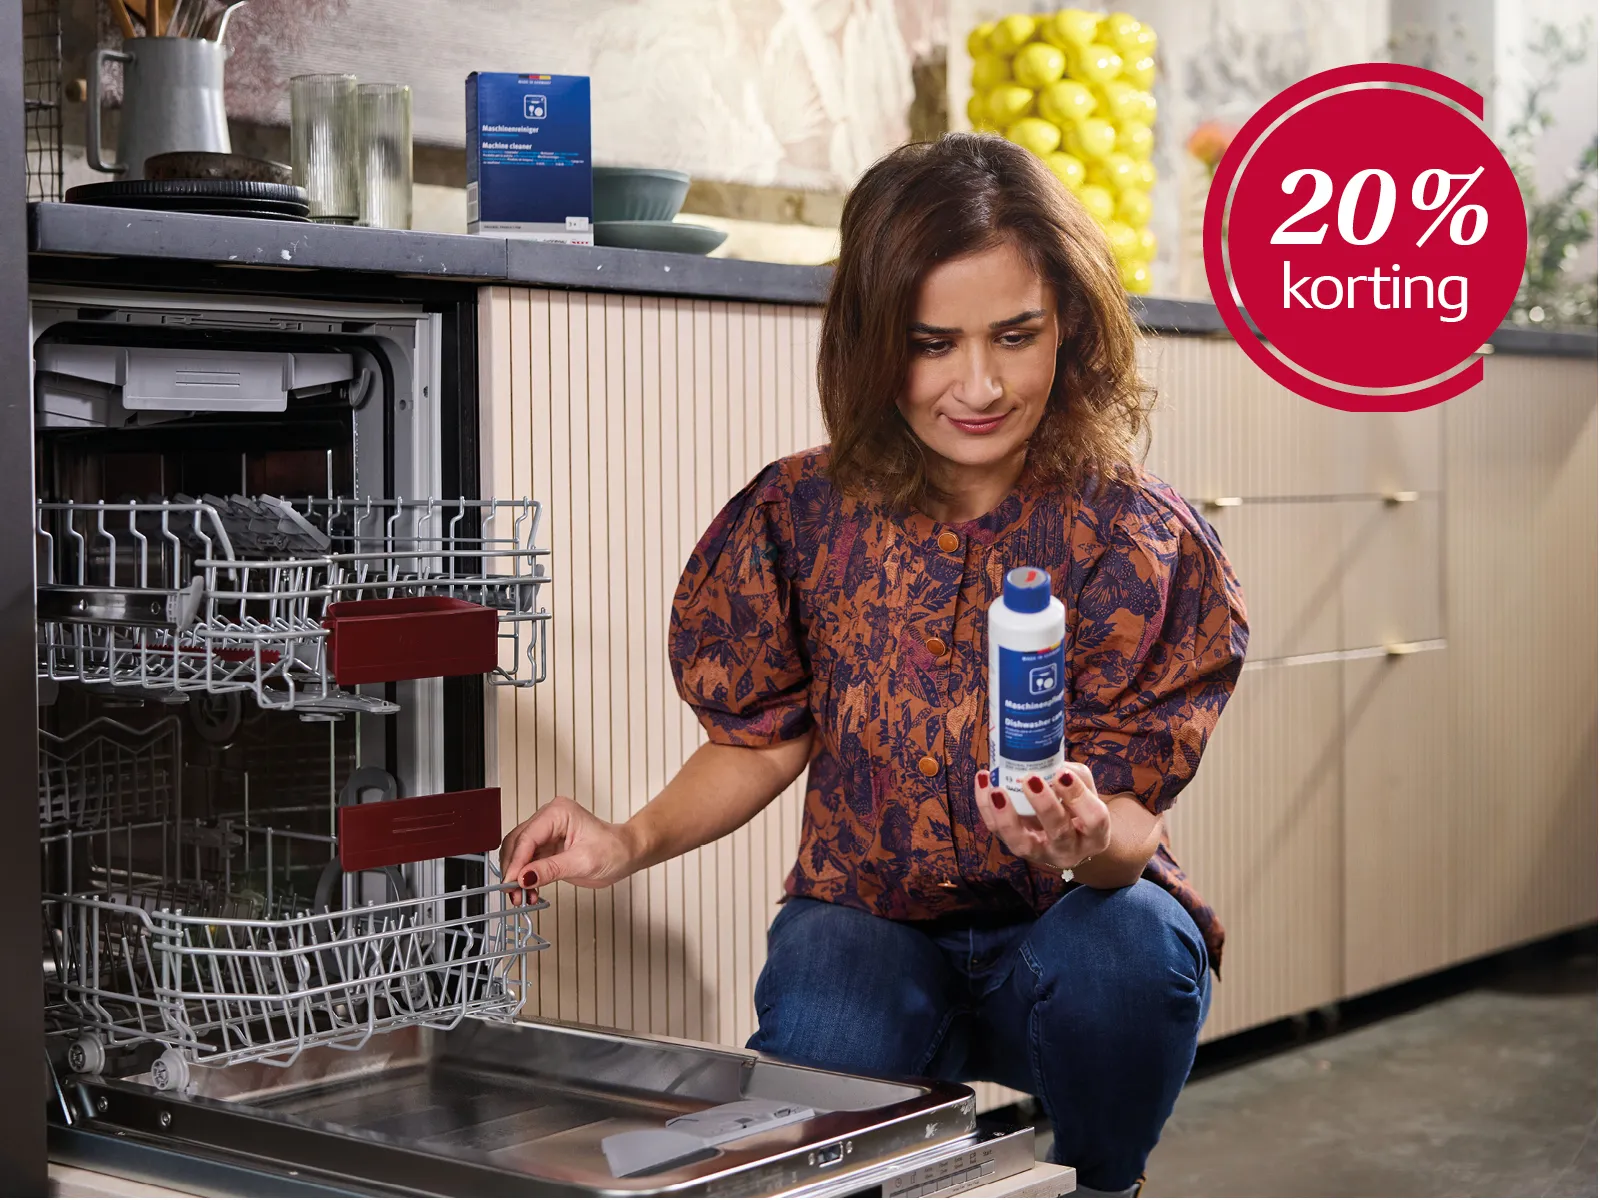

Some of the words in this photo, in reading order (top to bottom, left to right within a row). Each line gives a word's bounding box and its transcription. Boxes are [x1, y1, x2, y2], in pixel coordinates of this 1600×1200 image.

[482, 125, 539, 134] Maschinenreiniger
[509, 142, 532, 150] cleaner
[1005, 718, 1051, 728] Dishwasher
